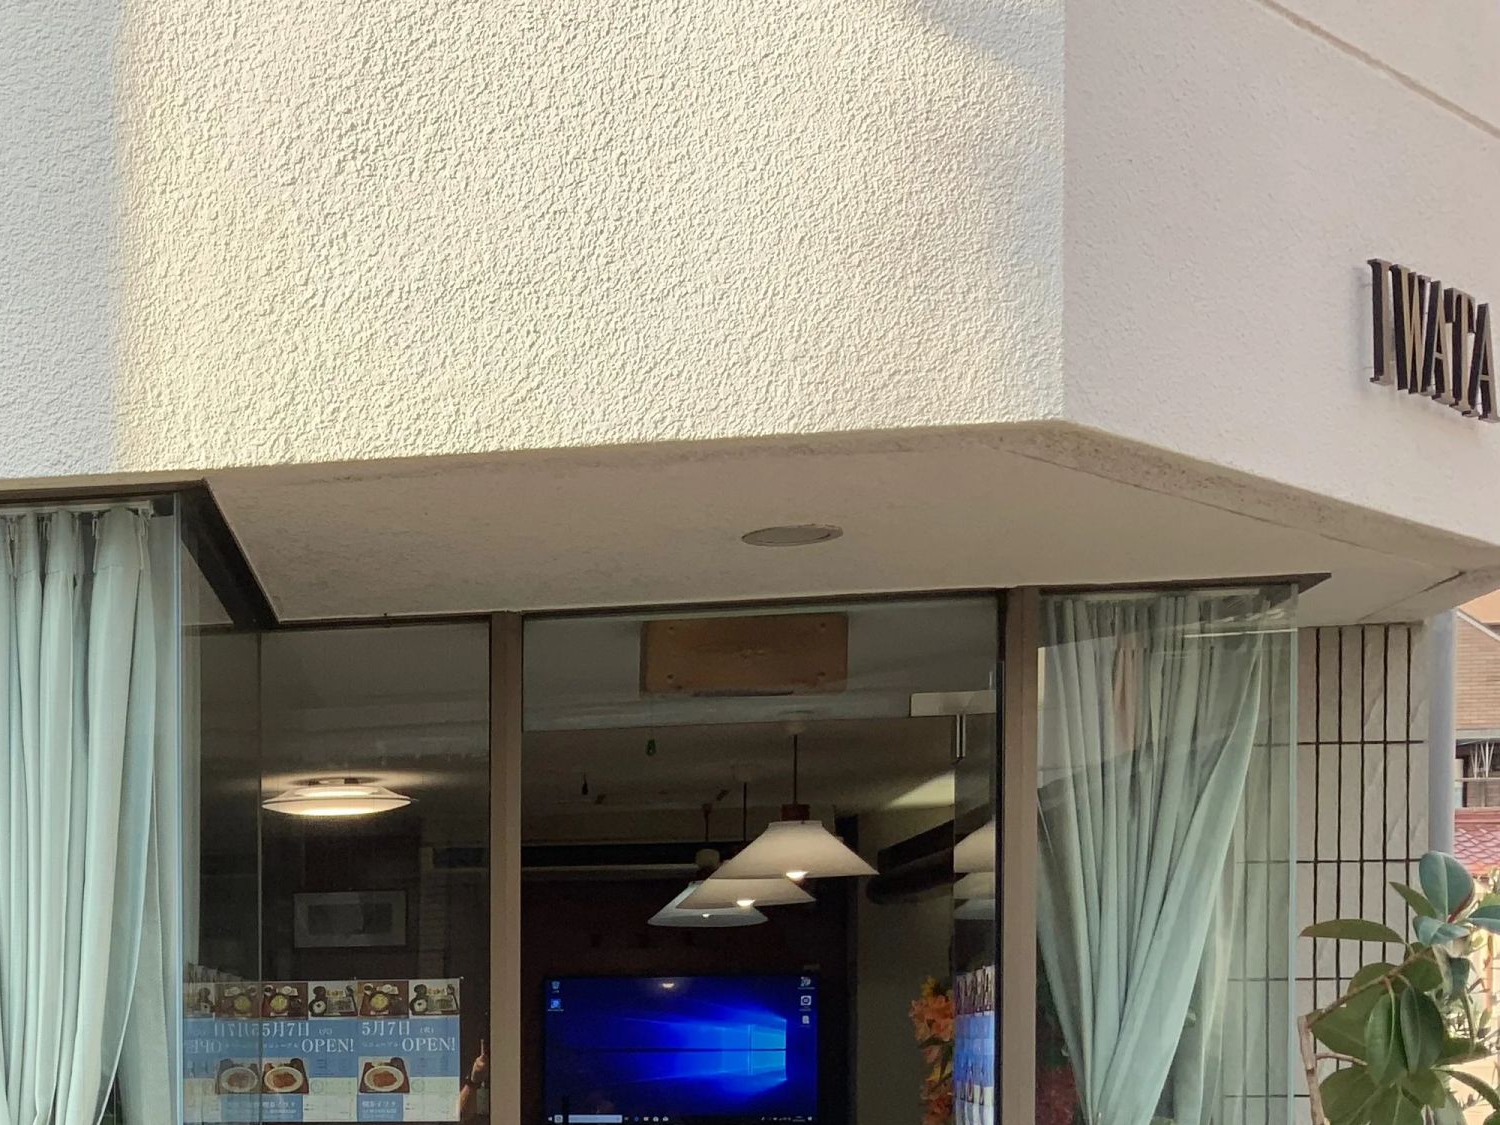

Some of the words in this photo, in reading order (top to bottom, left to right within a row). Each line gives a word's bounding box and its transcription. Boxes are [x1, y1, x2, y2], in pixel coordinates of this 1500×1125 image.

[1367, 258, 1500, 423] IWATA
[362, 1020, 410, 1036] 5月7日
[301, 1038, 354, 1053] OPEN!
[401, 1037, 456, 1052] OPEN!
